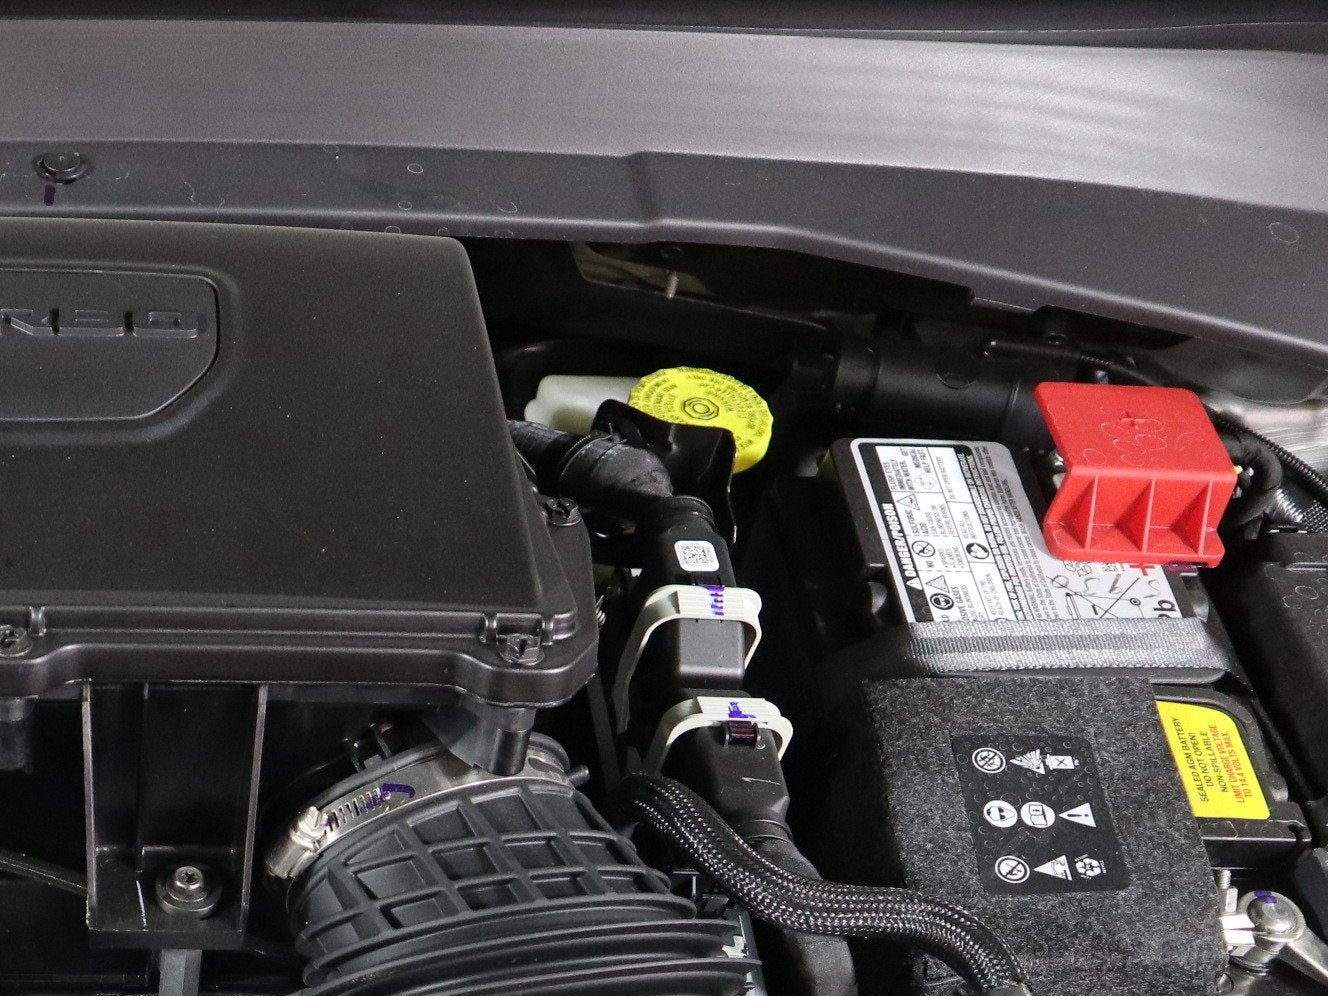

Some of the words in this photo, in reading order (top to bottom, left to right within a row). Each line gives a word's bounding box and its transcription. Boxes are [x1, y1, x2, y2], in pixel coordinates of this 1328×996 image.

[881, 503, 916, 576] DANGER/POISON
[1170, 717, 1190, 750] BATTERY
[1187, 732, 1203, 755] OPEN!
[1208, 724, 1226, 753] VOLTAGE
[1183, 752, 1197, 769] AGM
[1196, 758, 1209, 773] NOT
[1199, 731, 1228, 791] NON-SPILLABLE
[1219, 756, 1237, 782] CHARGE
[1227, 750, 1242, 769] VOLTS
[1190, 771, 1209, 801] SEALED
[1203, 775, 1214, 786] DO
[1236, 772, 1248, 786] 14.4
[1231, 785, 1245, 802] LIMIT
[1242, 788, 1252, 797] TO
